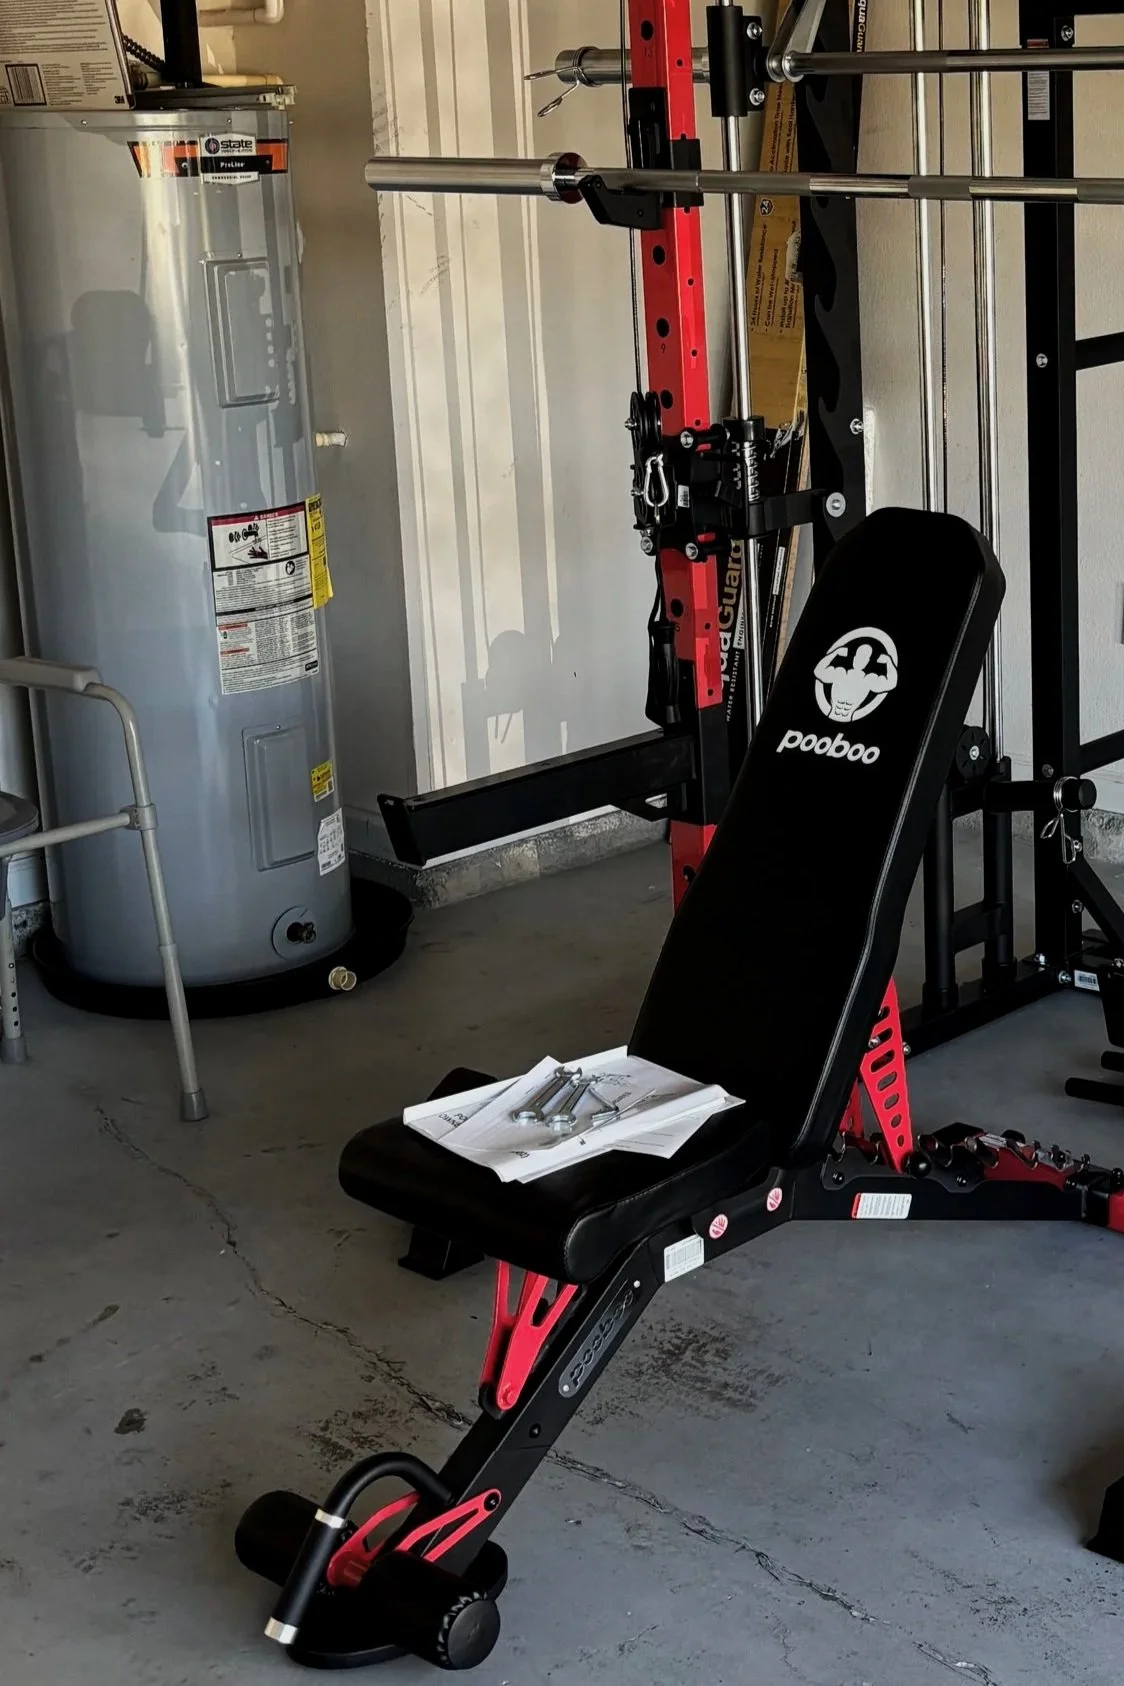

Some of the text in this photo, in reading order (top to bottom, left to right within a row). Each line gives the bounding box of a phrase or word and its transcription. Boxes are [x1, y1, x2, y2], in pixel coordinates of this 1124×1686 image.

[857, 0, 867, 52] quaGuar
[220, 139, 253, 149] state
[762, 200, 771, 213] 24
[776, 729, 881, 765] pooboo
[569, 1289, 634, 1390] pooboo
